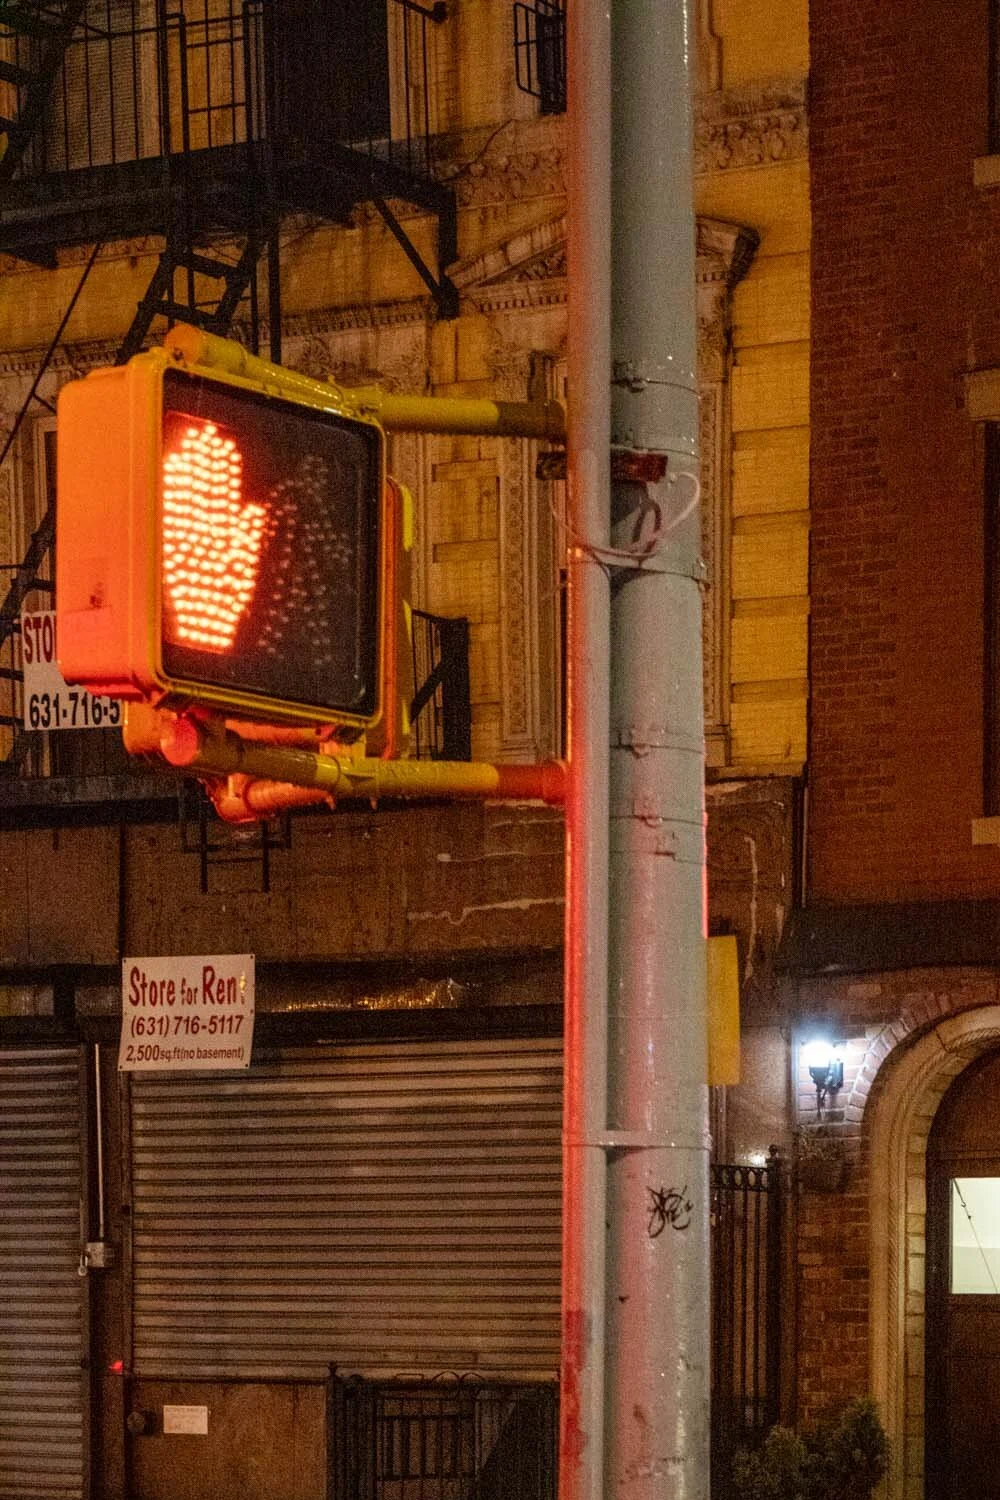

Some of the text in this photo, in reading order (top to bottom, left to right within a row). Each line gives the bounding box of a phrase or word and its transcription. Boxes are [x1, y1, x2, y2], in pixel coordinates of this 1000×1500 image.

[23, 615, 57, 664] STO
[129, 966, 176, 1007] Store
[181, 977, 198, 1005] for
[131, 1014, 244, 1038] (631) 716-5117
[196, 1046, 245, 1061] basement)
